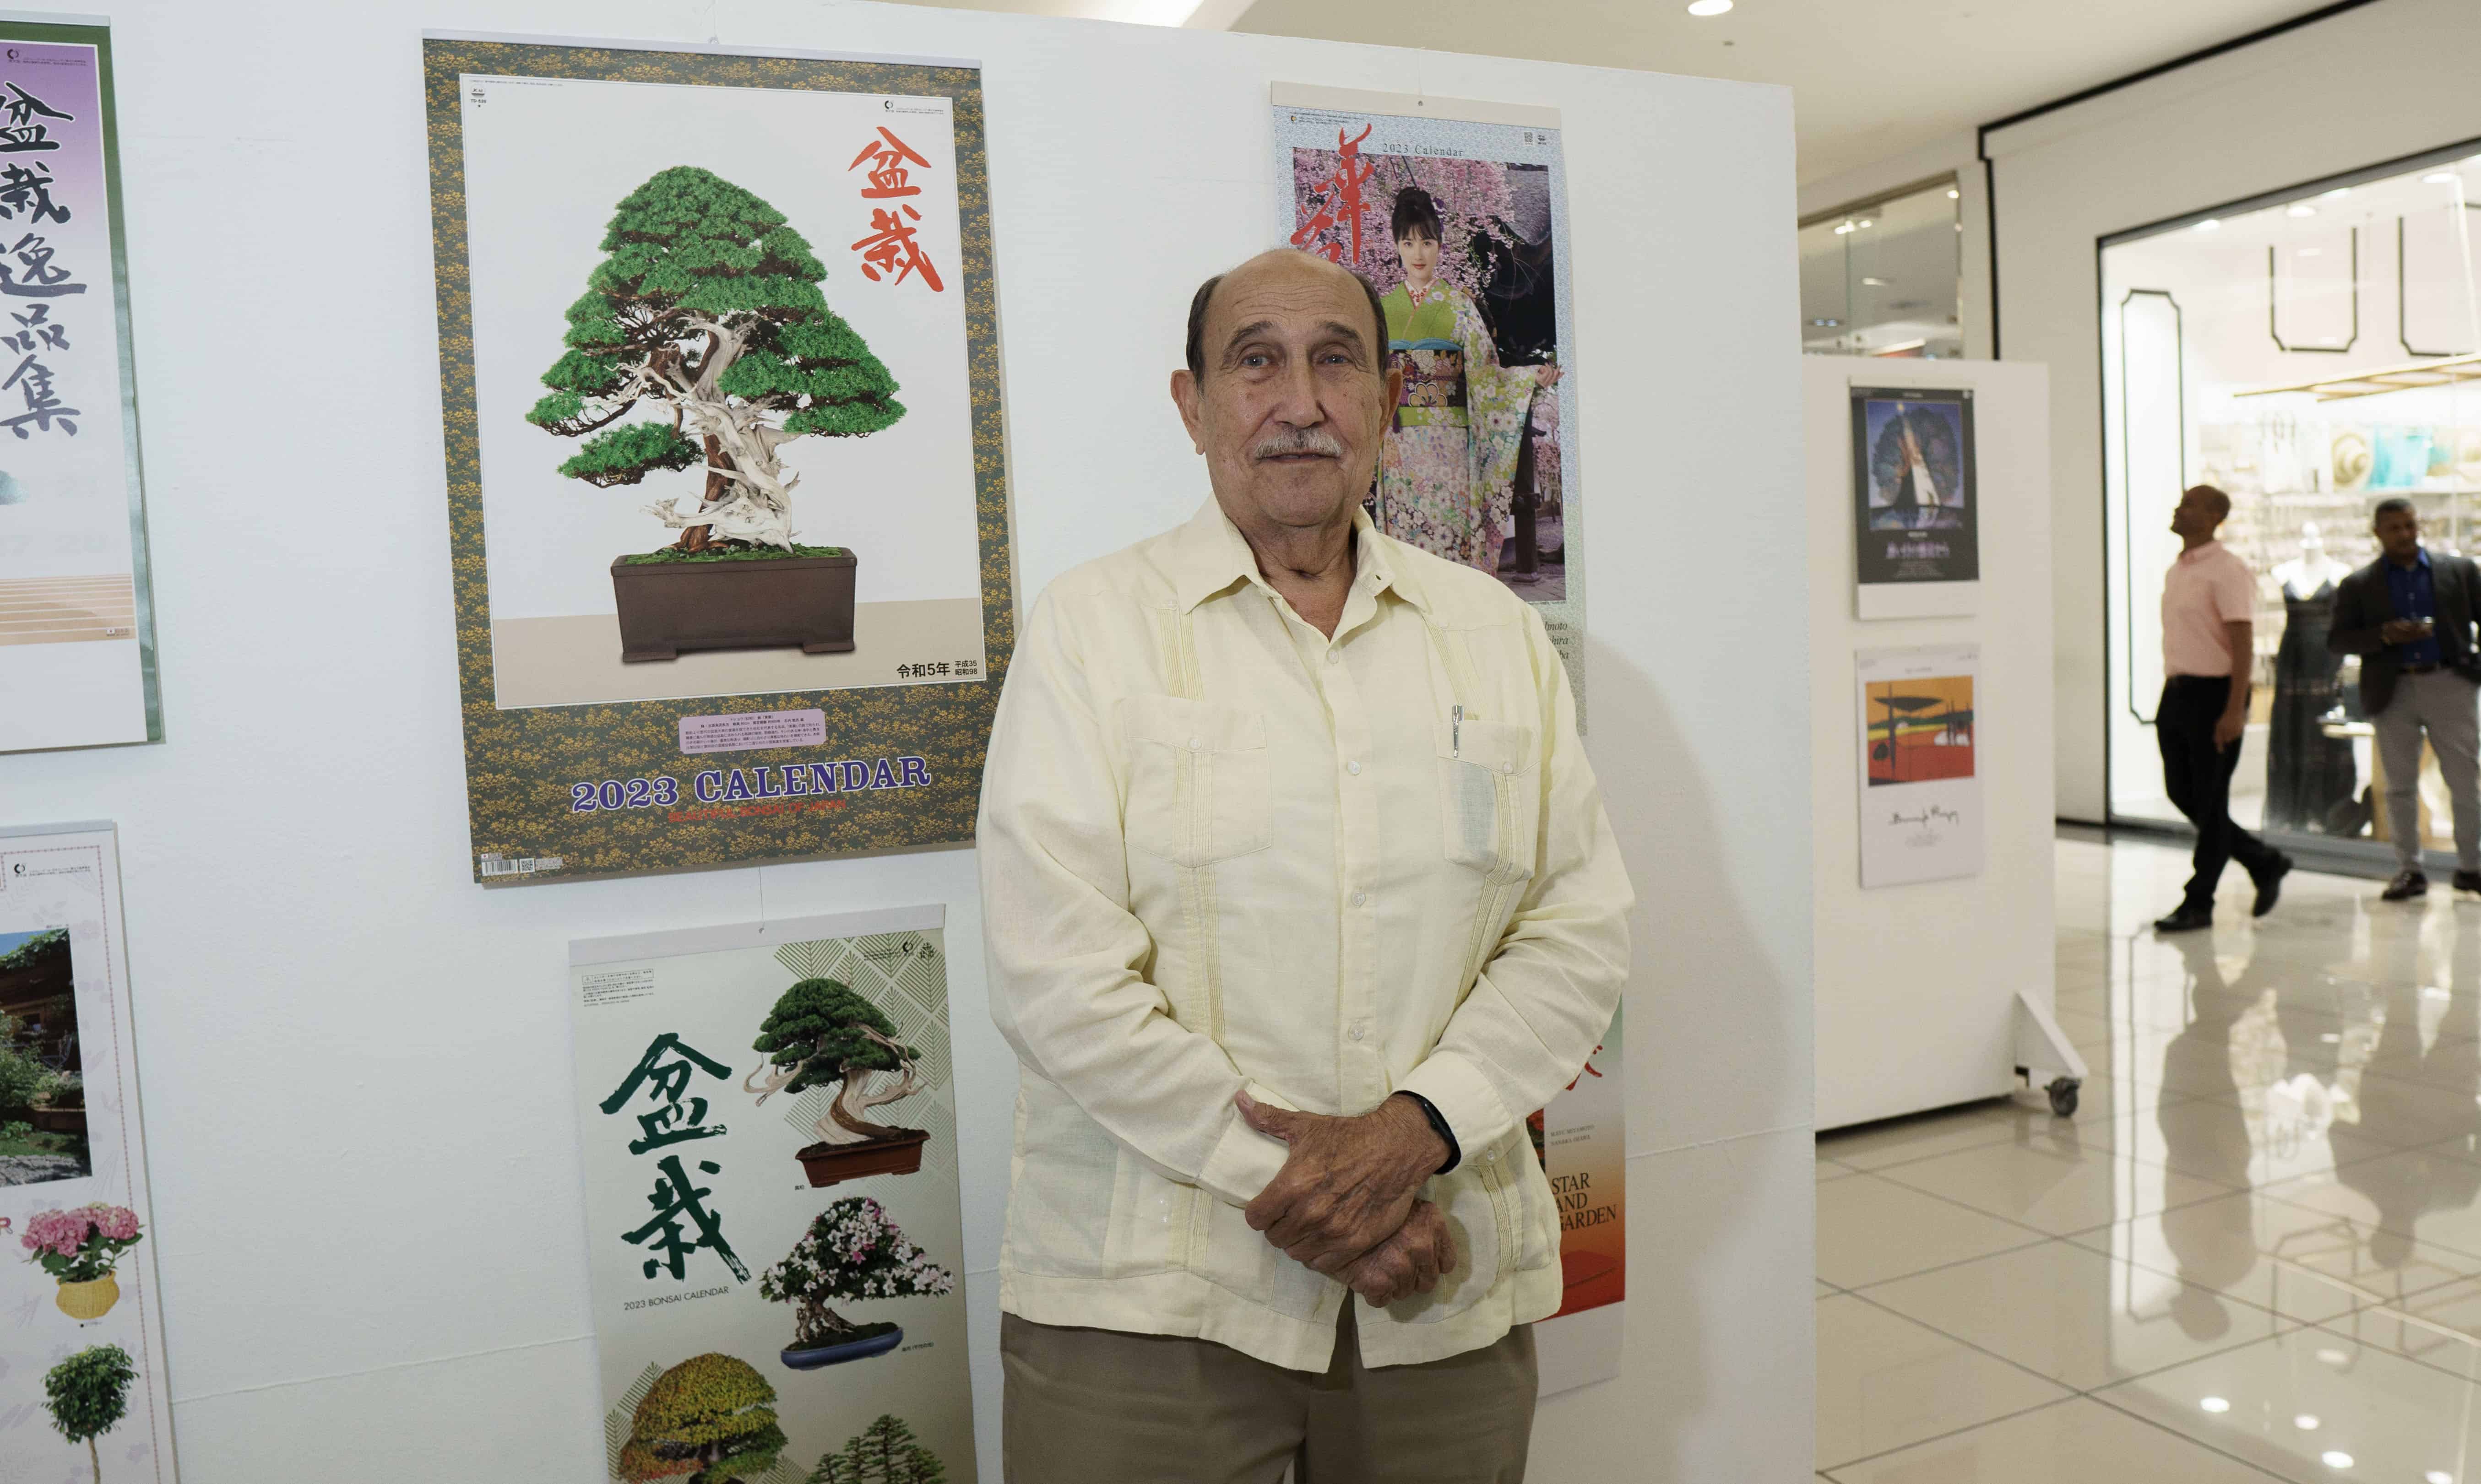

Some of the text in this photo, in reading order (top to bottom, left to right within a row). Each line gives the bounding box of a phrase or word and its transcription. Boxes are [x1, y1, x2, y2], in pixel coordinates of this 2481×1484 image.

[1382, 143, 1465, 157] 2023 Calendar
[848, 126, 944, 292] 盆栽
[896, 661, 950, 678] 令和5年
[955, 660, 977, 668] 平成35
[572, 756, 931, 812] 2023 CALENDAR
[668, 799, 847, 823] BEAUTIFUL BONSAI OF JAPAN
[599, 1033, 751, 1284] 盆栽
[1552, 1172, 1590, 1194] STAR
[624, 1286, 729, 1310] 2023 BONSAI CALENDAR
